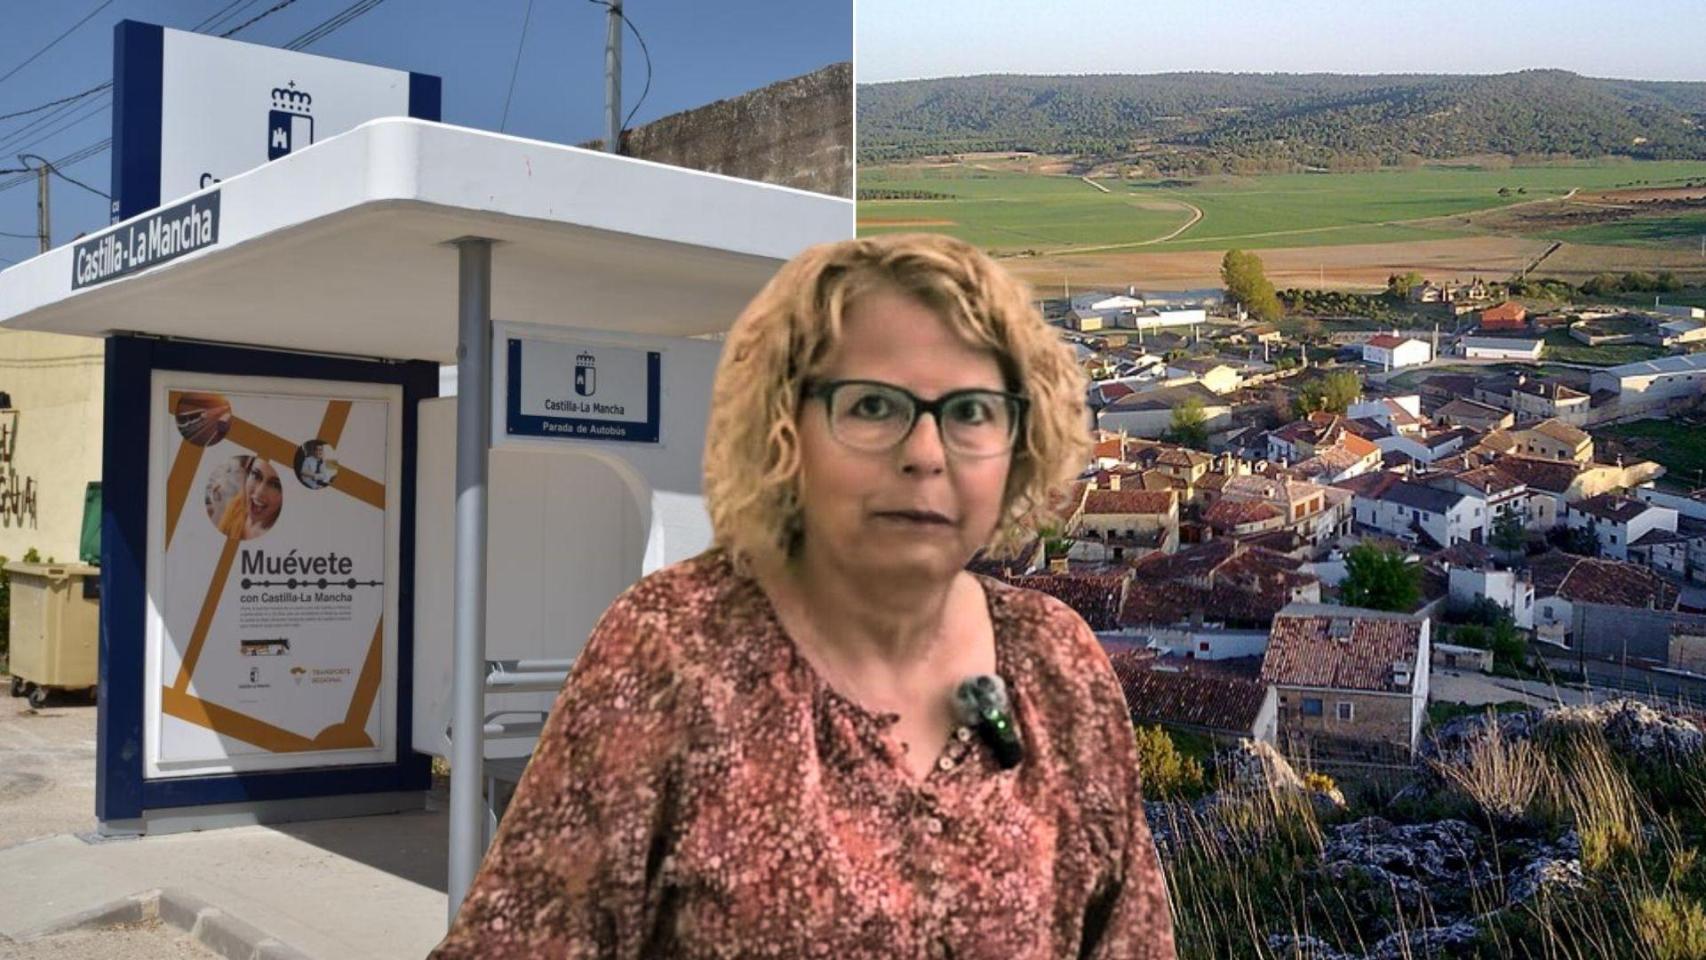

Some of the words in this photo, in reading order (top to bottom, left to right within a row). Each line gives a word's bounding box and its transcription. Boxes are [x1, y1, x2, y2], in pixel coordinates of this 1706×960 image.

[77, 227, 146, 285] Castilla-La
[149, 204, 212, 260] Mancha
[545, 399, 591, 413] Castilla-La
[593, 400, 625, 416] Mancha
[543, 421, 574, 433] Parada
[576, 423, 588, 434] de
[590, 424, 626, 437] Autobús
[241, 549, 353, 575] Muévete
[240, 594, 259, 603] con
[261, 592, 312, 603] Castilla-La
[315, 592, 353, 602] Mancha
